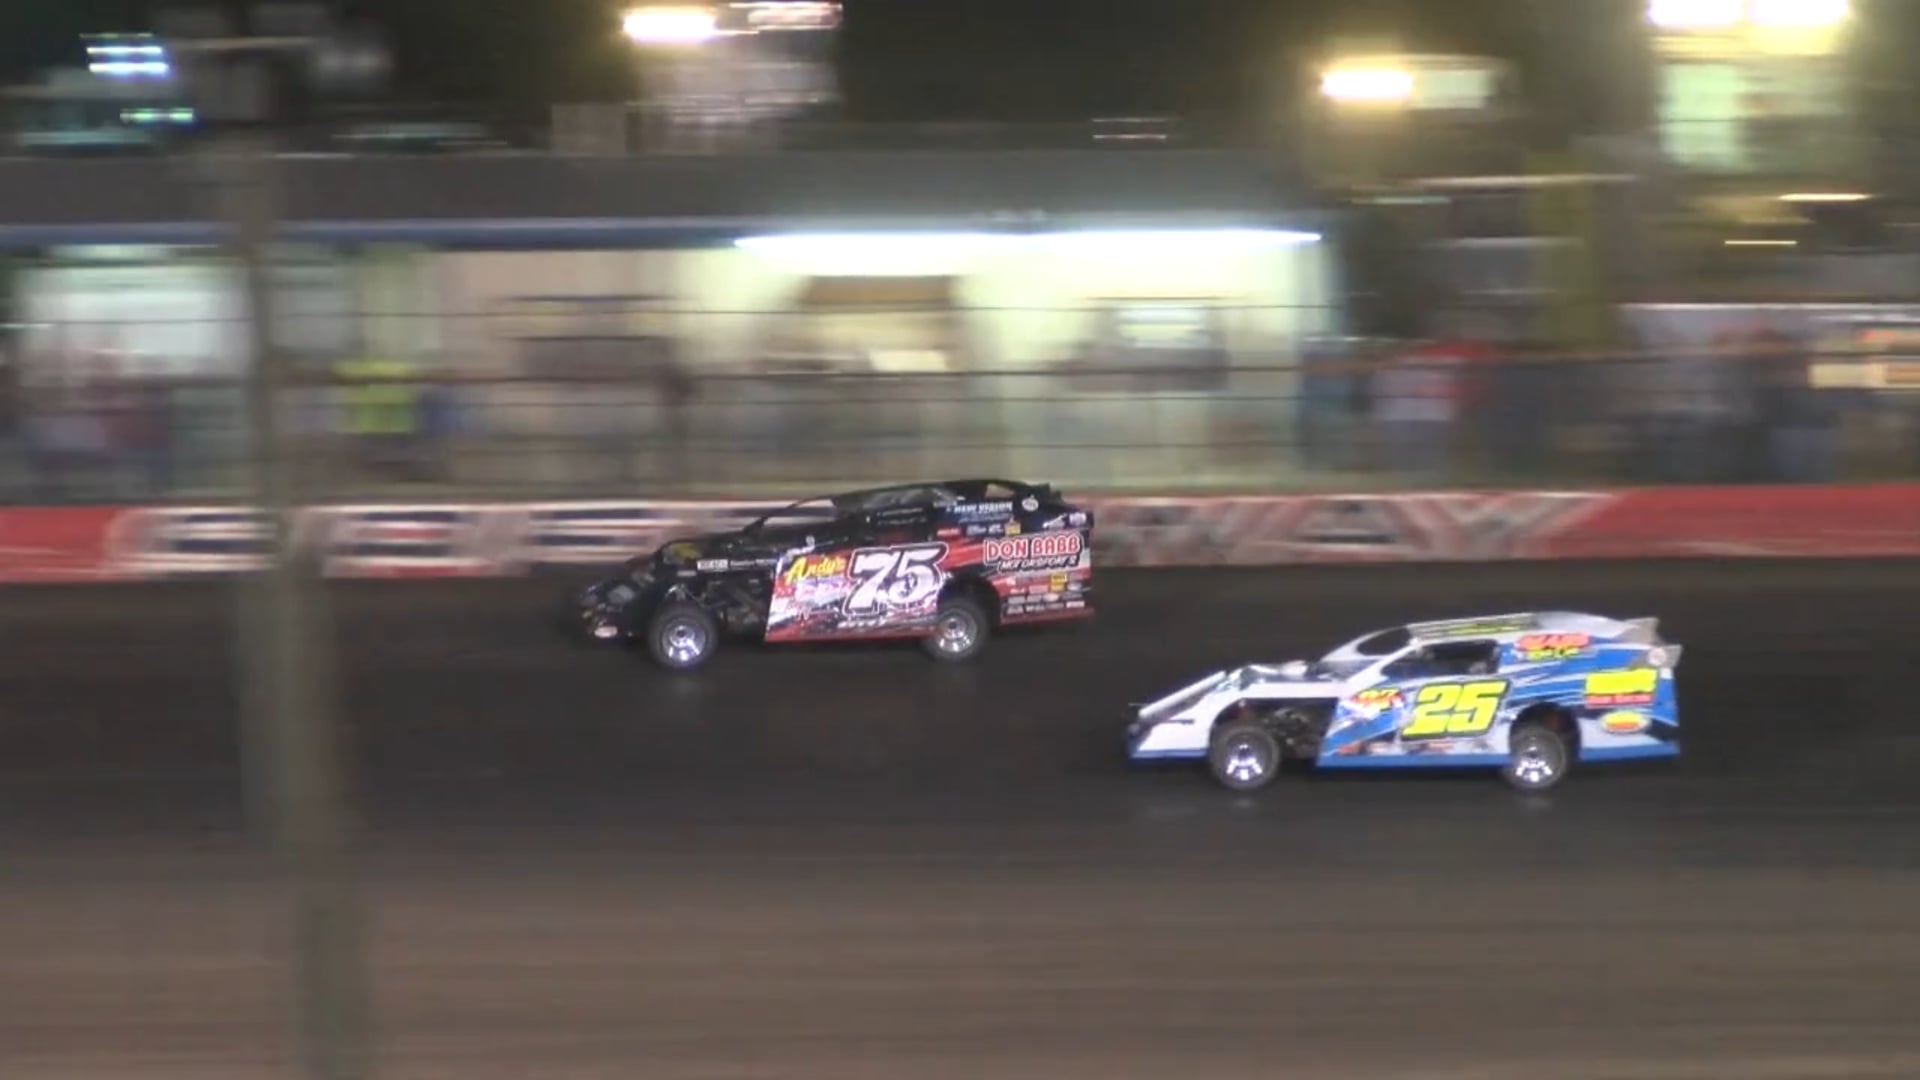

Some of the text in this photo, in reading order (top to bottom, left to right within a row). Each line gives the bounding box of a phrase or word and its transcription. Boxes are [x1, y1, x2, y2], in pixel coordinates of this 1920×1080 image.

[984, 534, 1081, 563] DON BABB
[847, 545, 944, 612] 75
[1402, 679, 1508, 738] 25
